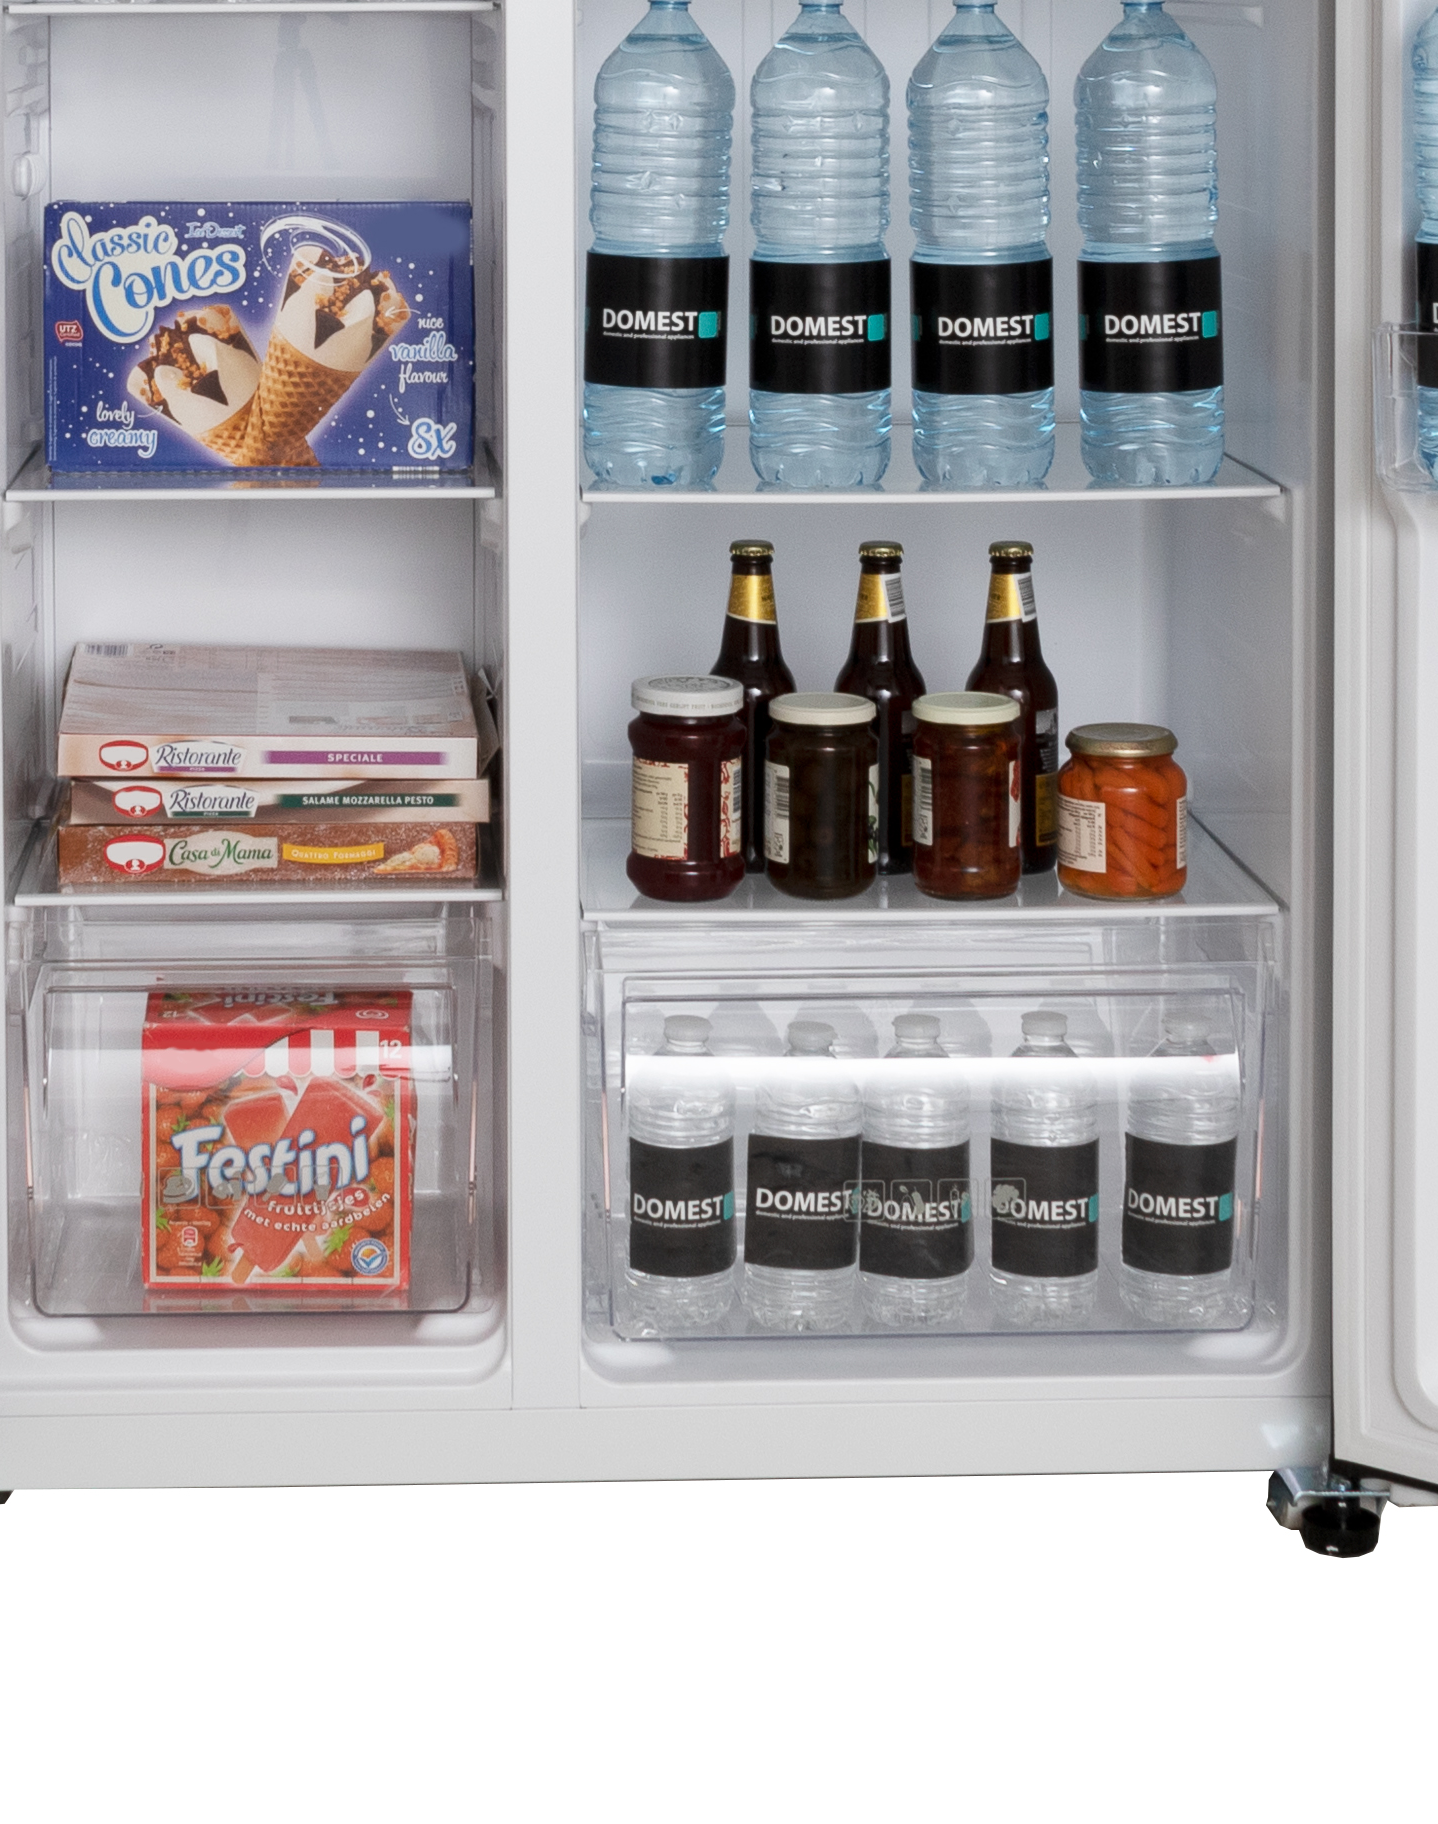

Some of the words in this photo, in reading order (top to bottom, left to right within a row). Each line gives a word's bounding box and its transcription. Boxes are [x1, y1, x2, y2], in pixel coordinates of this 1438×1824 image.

[92, 249, 241, 338] Cones
[59, 324, 78, 334] UTZ
[418, 312, 444, 329] nice
[603, 308, 698, 332] DOMEST
[770, 314, 867, 337] DOMEST
[938, 313, 1034, 337] DOMEST
[1104, 311, 1201, 335] DOMEST
[389, 330, 458, 363] vanilla
[398, 362, 448, 394] flavour
[96, 401, 135, 429] lovely
[87, 429, 158, 458] creamy
[155, 743, 242, 768] Ristorante
[327, 753, 384, 763] SPECIALE
[168, 788, 255, 813] Ristorante
[302, 796, 340, 806] SALAME
[342, 796, 403, 806] MOZZARELLA
[405, 795, 435, 806] PESTO
[168, 839, 209, 866] Casa
[208, 837, 274, 869] Mama
[379, 1039, 402, 1060] 12
[170, 1115, 370, 1200] Festini
[243, 1207, 270, 1227] met
[274, 1220, 316, 1232] echte
[321, 1191, 391, 1231] aardbeien
[633, 1193, 724, 1221] DOMEST
[756, 1187, 852, 1213] DOMEST
[1128, 1187, 1219, 1219] DOMEST
